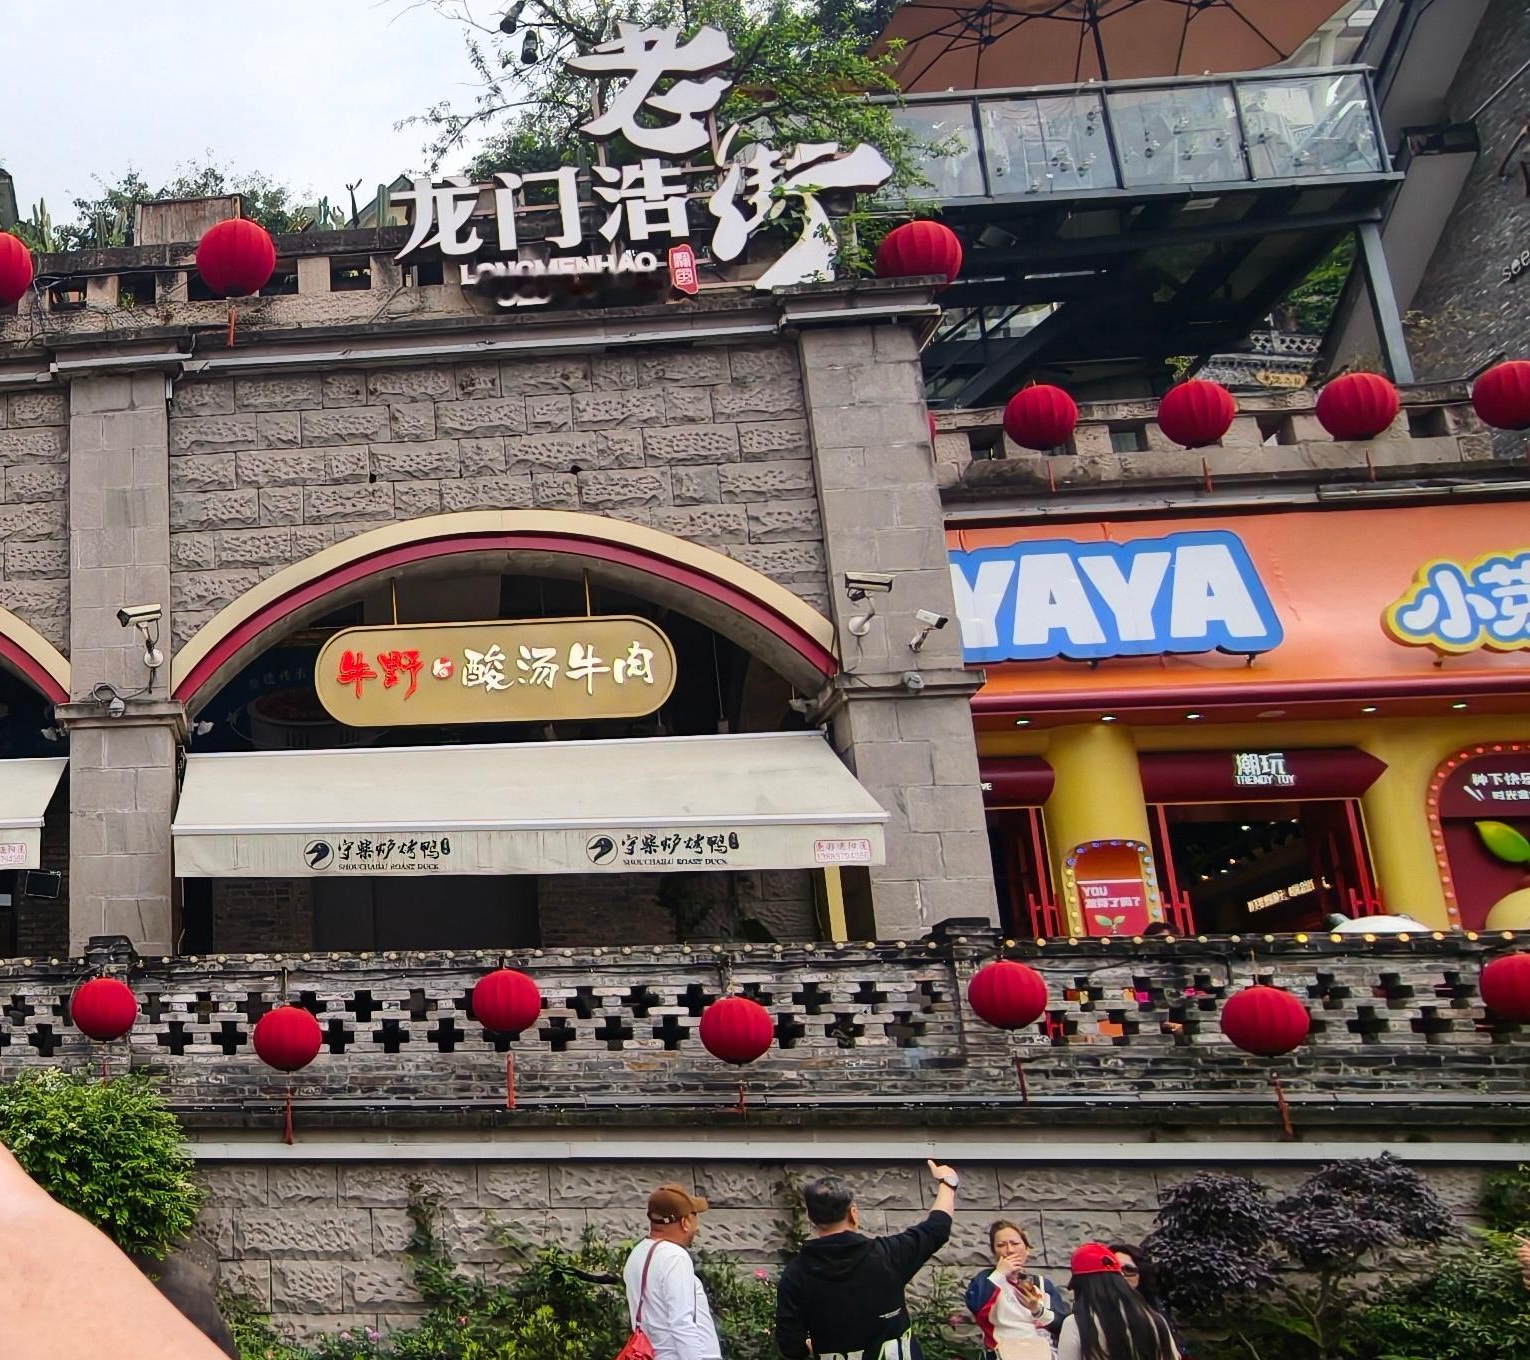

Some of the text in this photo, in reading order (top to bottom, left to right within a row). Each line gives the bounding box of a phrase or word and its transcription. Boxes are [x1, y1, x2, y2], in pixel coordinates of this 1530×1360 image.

[949, 544, 1268, 648] YAYA
[462, 641, 655, 694] 酸汤牛肉
[338, 839, 439, 860] 守柴炉烤鸭
[622, 832, 727, 855] 守柴炉烤鸭
[1081, 886, 1108, 897] YOU
